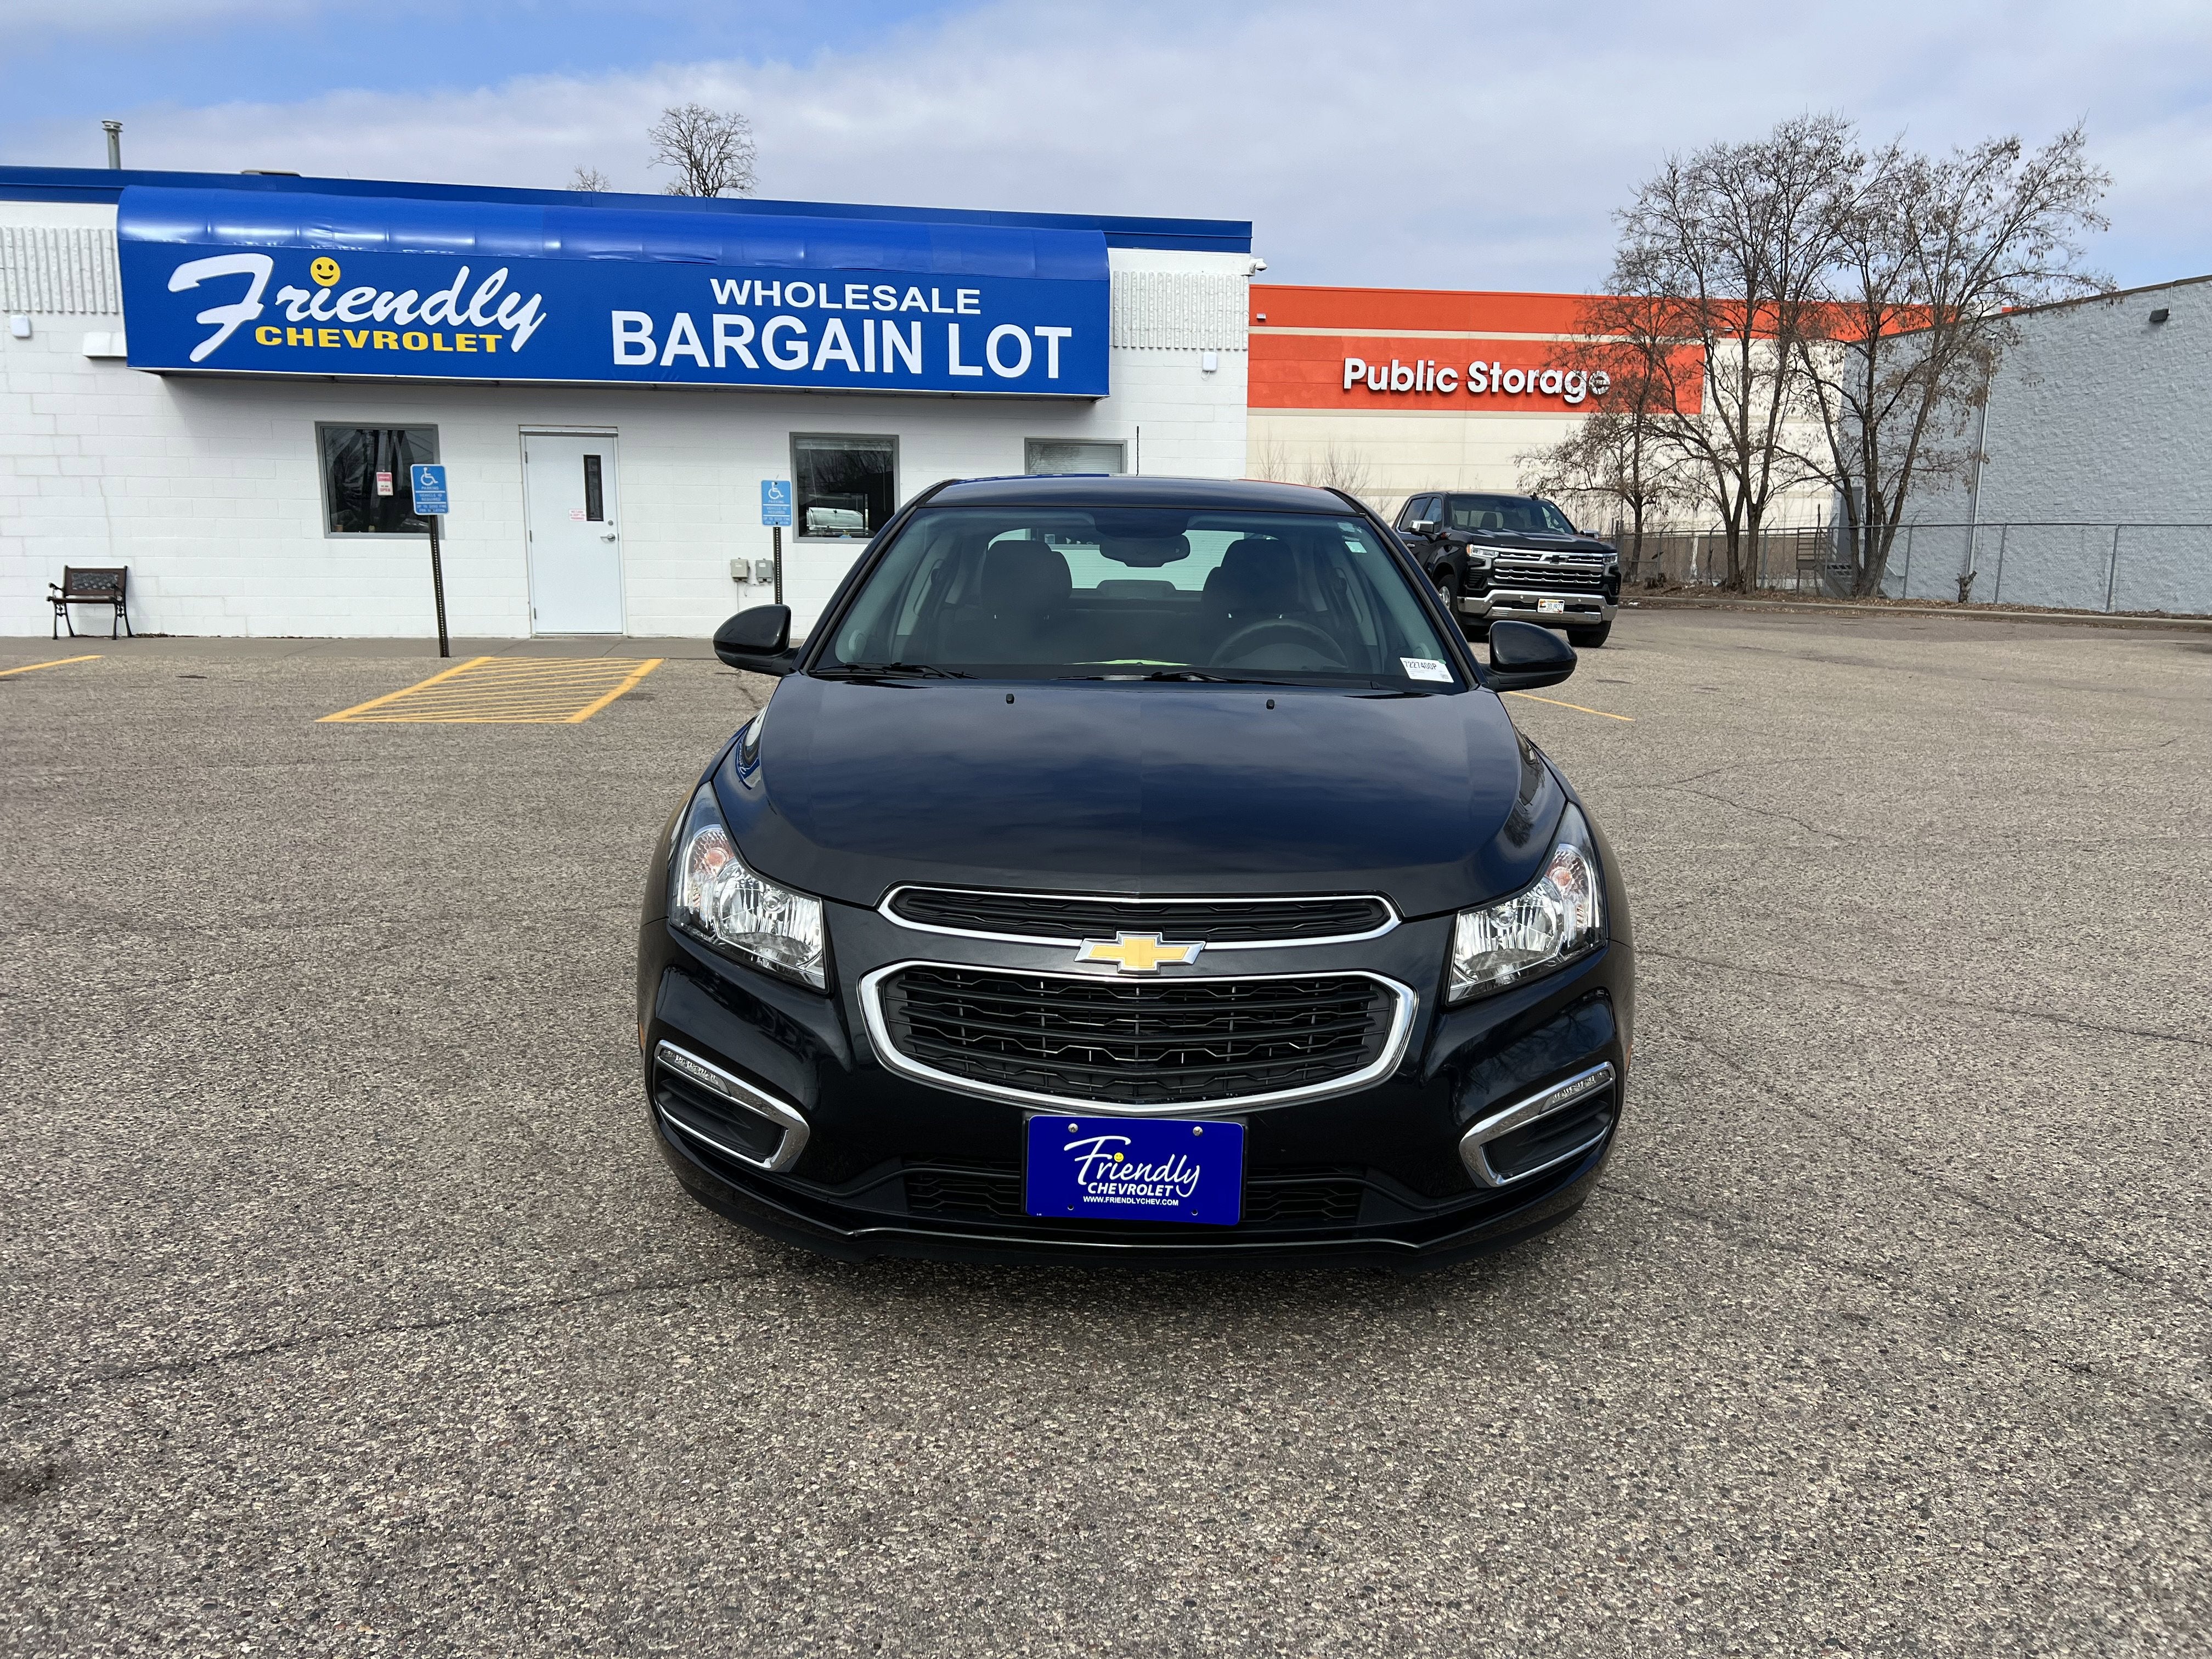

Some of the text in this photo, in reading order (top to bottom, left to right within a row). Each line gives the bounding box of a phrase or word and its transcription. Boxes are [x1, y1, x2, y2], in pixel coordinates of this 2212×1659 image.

[167, 253, 547, 363] Friendly
[710, 278, 981, 314] WHOLESALE
[255, 326, 503, 353] CHEVROLET
[611, 311, 1072, 379] BARGAIN LOT
[1343, 357, 1611, 404] Public Storage
[1063, 1135, 1200, 1198] Friendly
[1083, 1196, 1179, 1206] WWW.FRIENDLYCHEV.COM
[1087, 1182, 1173, 1197] CHEVROLET
